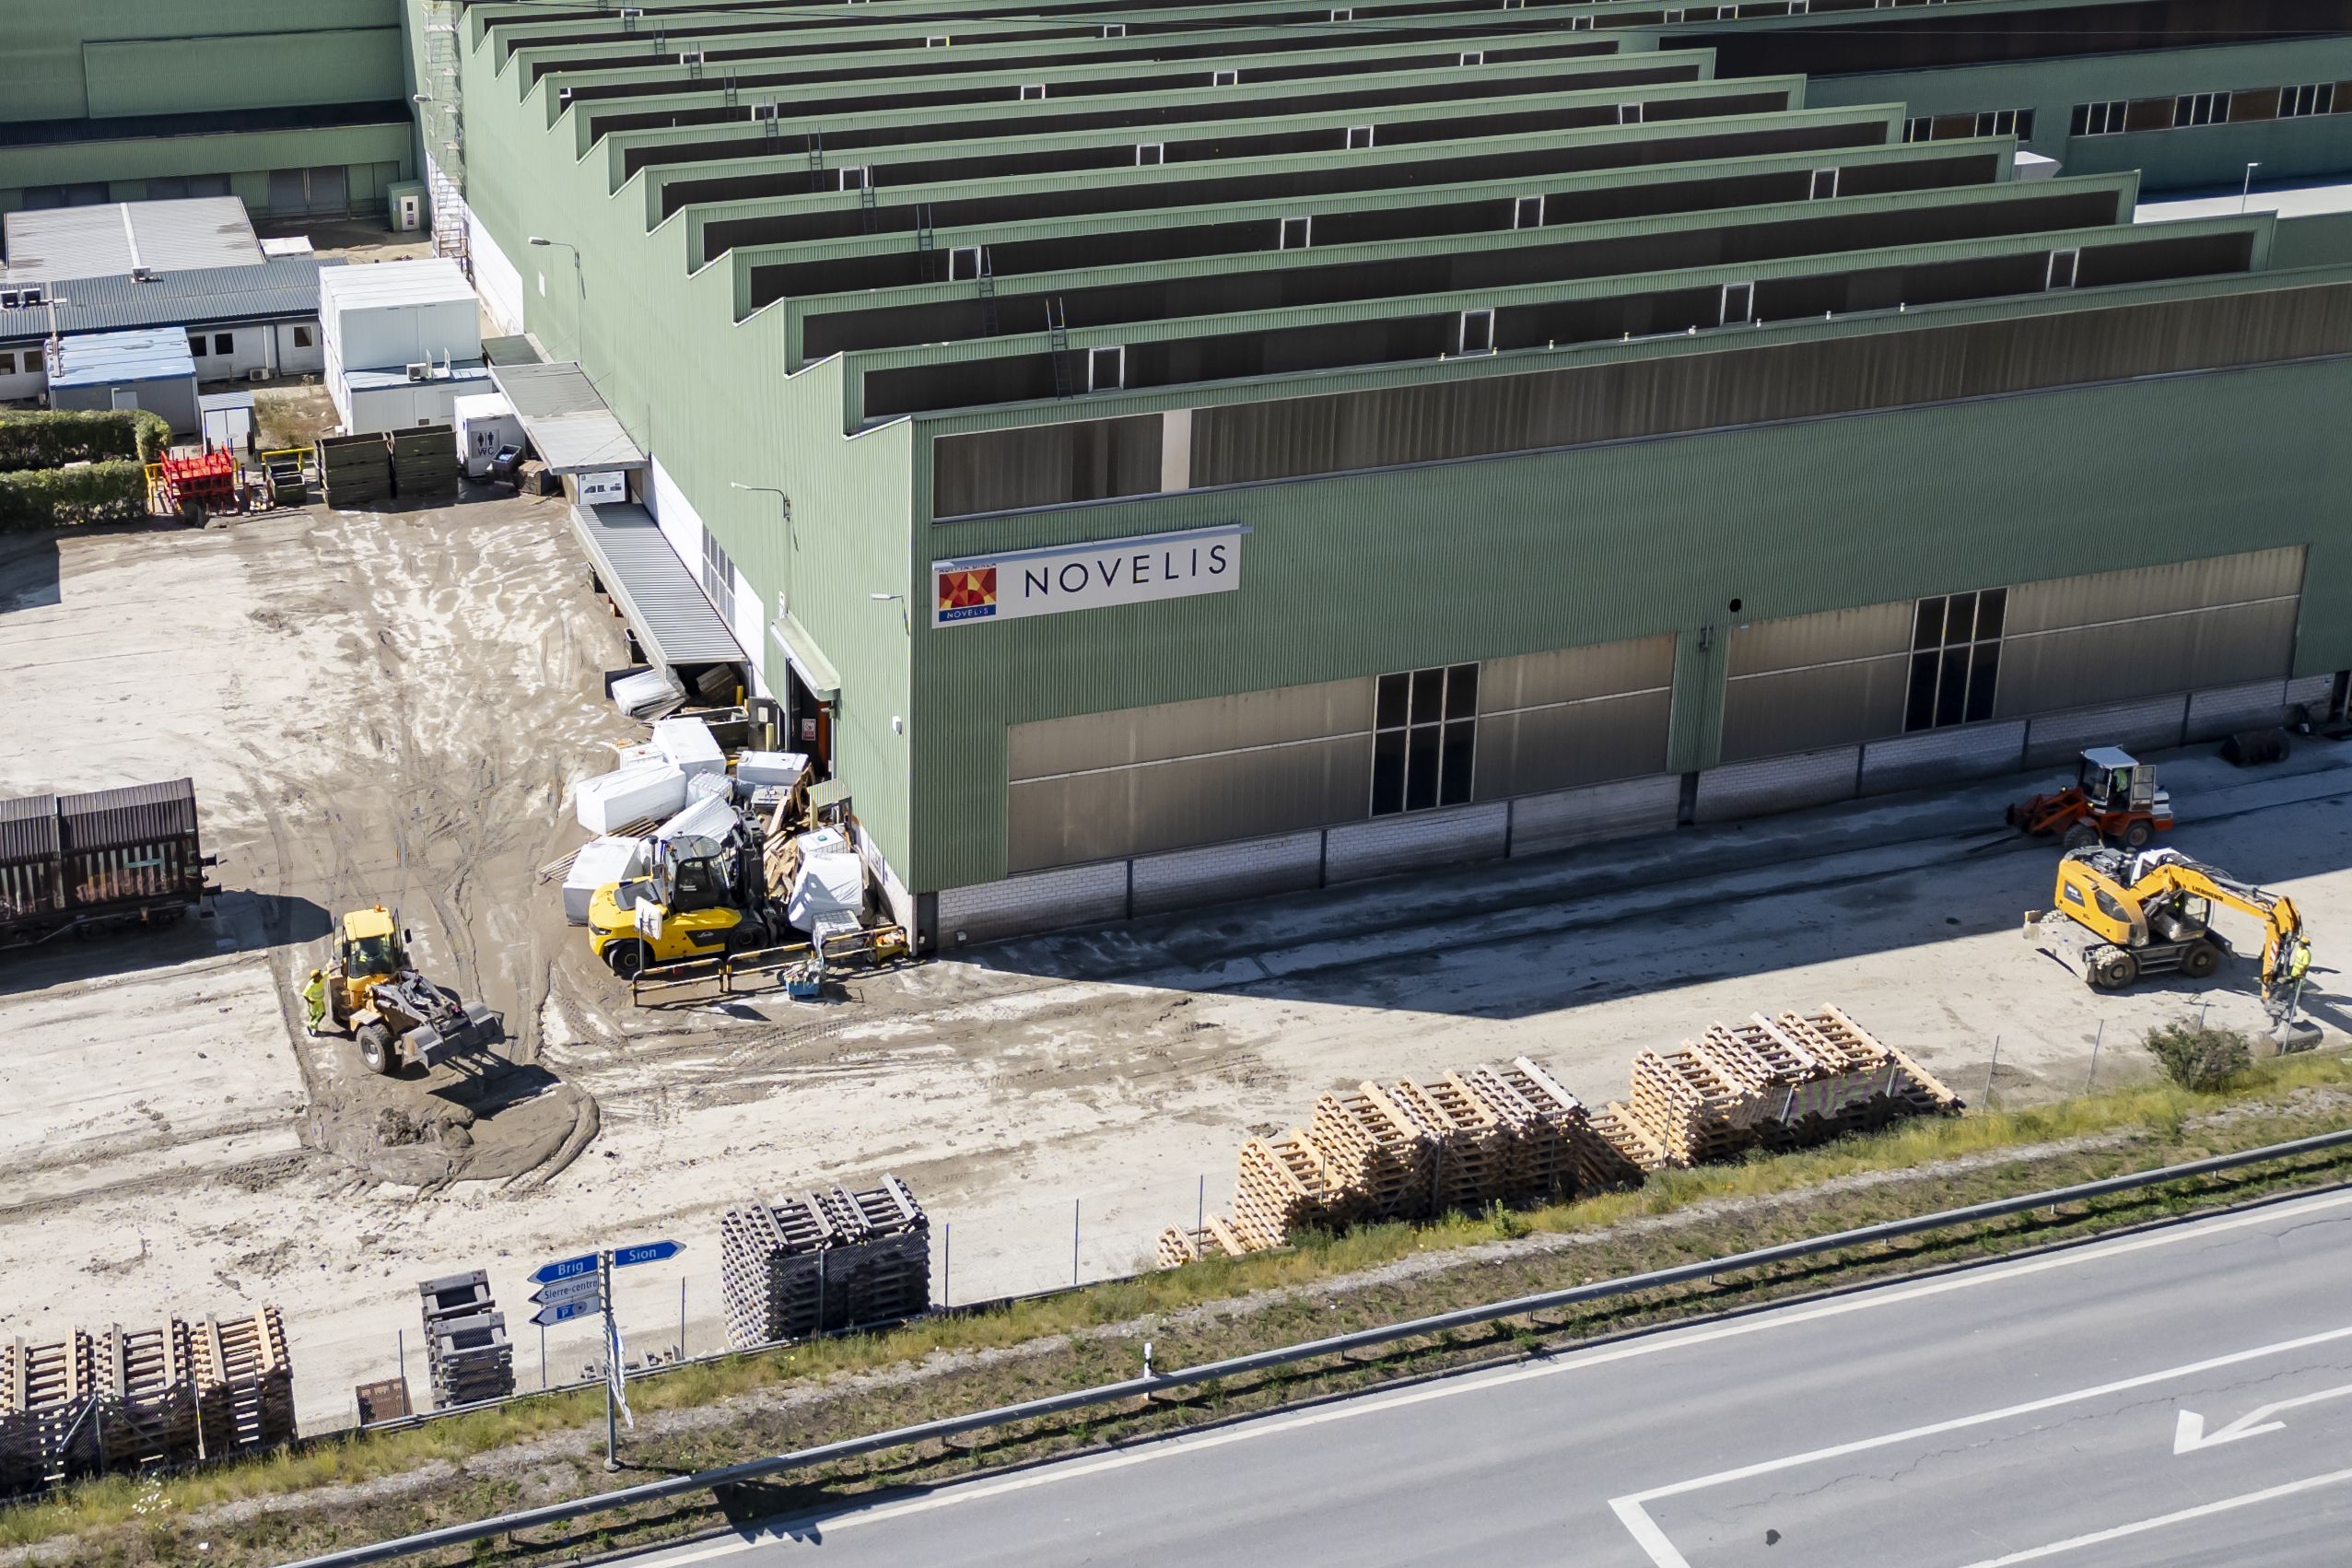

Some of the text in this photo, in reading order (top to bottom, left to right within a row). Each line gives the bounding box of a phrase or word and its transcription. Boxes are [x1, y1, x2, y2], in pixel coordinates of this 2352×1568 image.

[477, 446, 495, 456] WC
[1025, 544, 1226, 598] NOVELIS
[946, 607, 989, 619] NOVELIS
[629, 1248, 657, 1261] Sion
[558, 1260, 584, 1275] Brig
[544, 1280, 598, 1300] Sierre-centre
[561, 1308, 568, 1317] P
